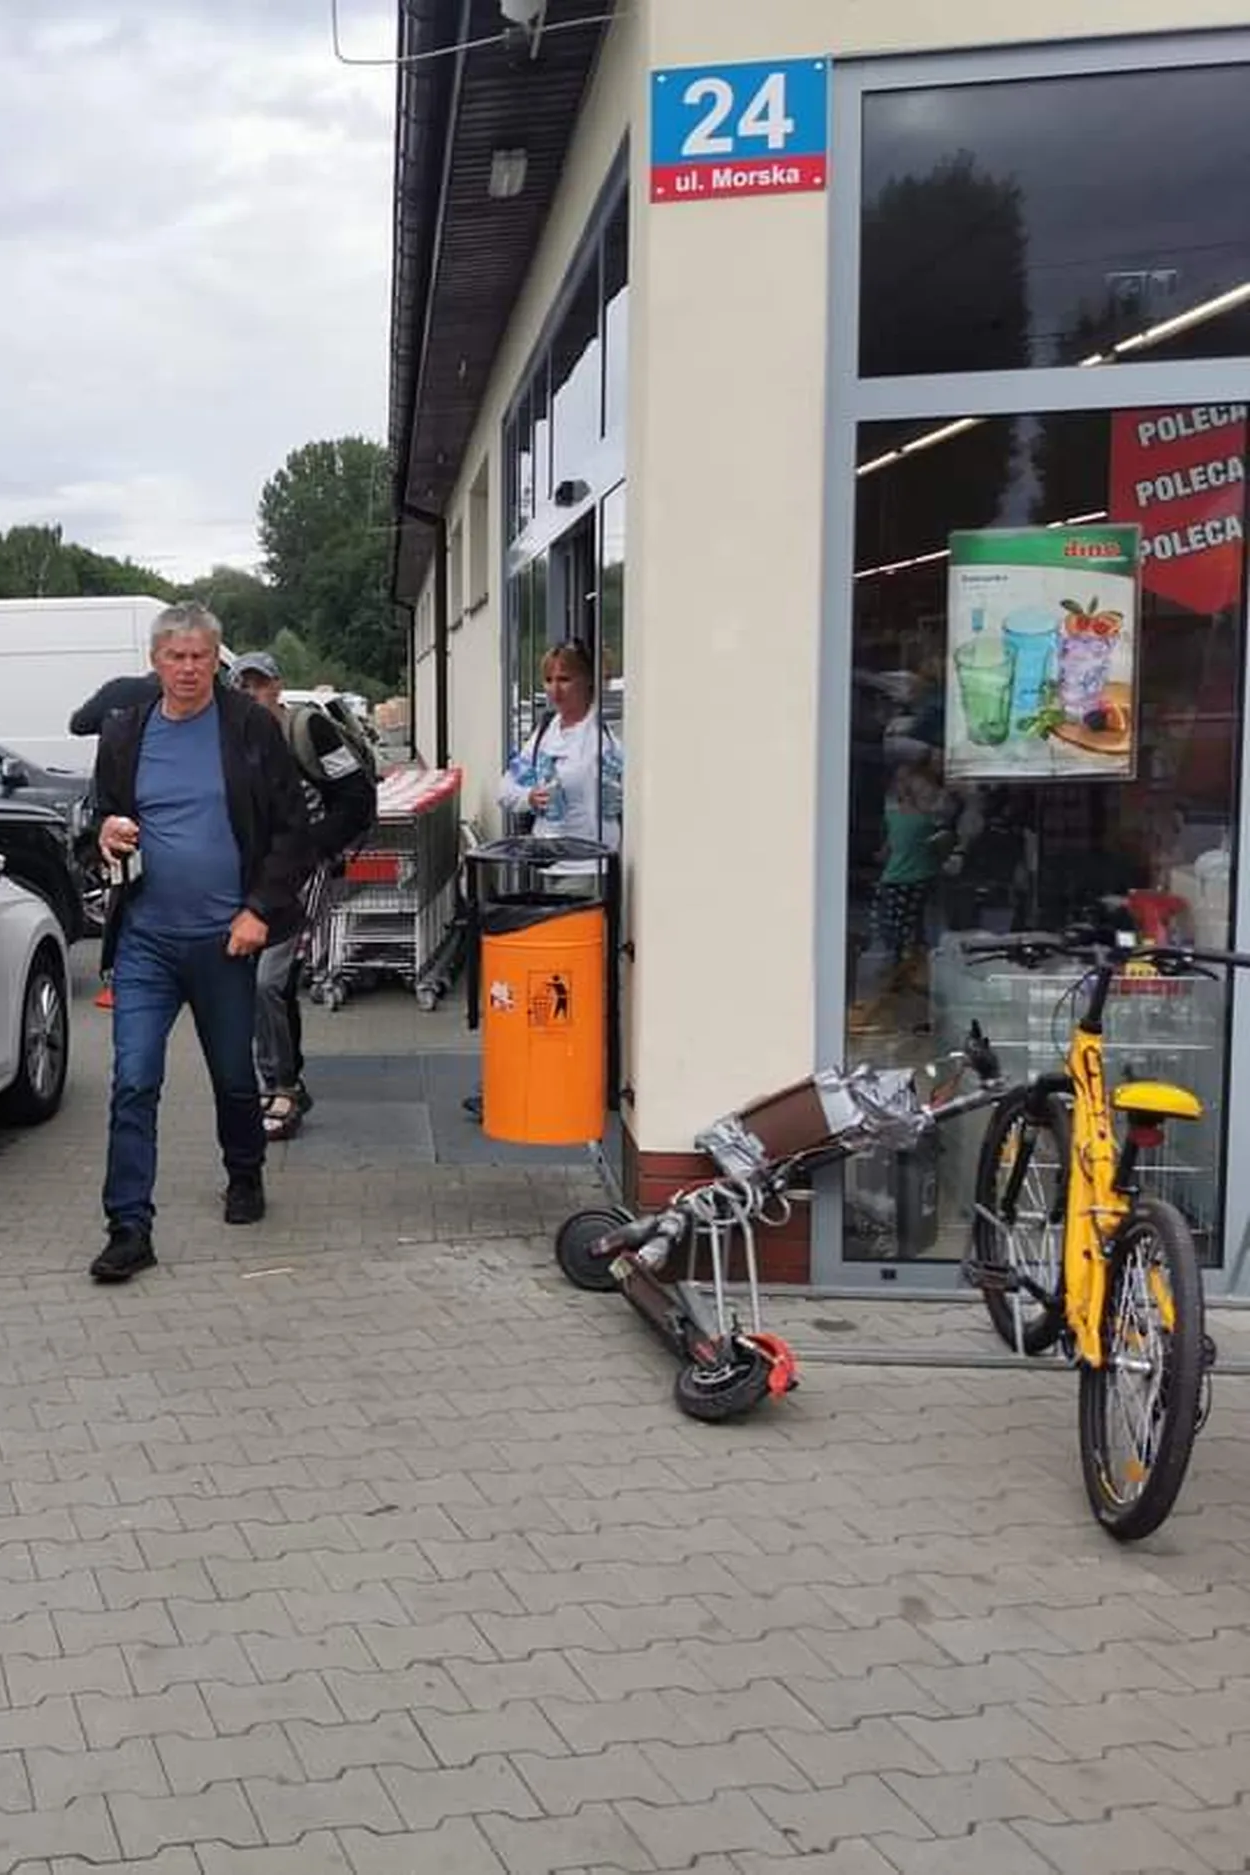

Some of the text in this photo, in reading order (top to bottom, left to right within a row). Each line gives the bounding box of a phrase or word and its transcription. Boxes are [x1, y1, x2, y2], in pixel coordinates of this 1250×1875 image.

[681, 72, 795, 157] 24
[675, 164, 801, 193] ul. Morska
[1137, 404, 1247, 447] POLECA
[1135, 456, 1245, 508] POLECA
